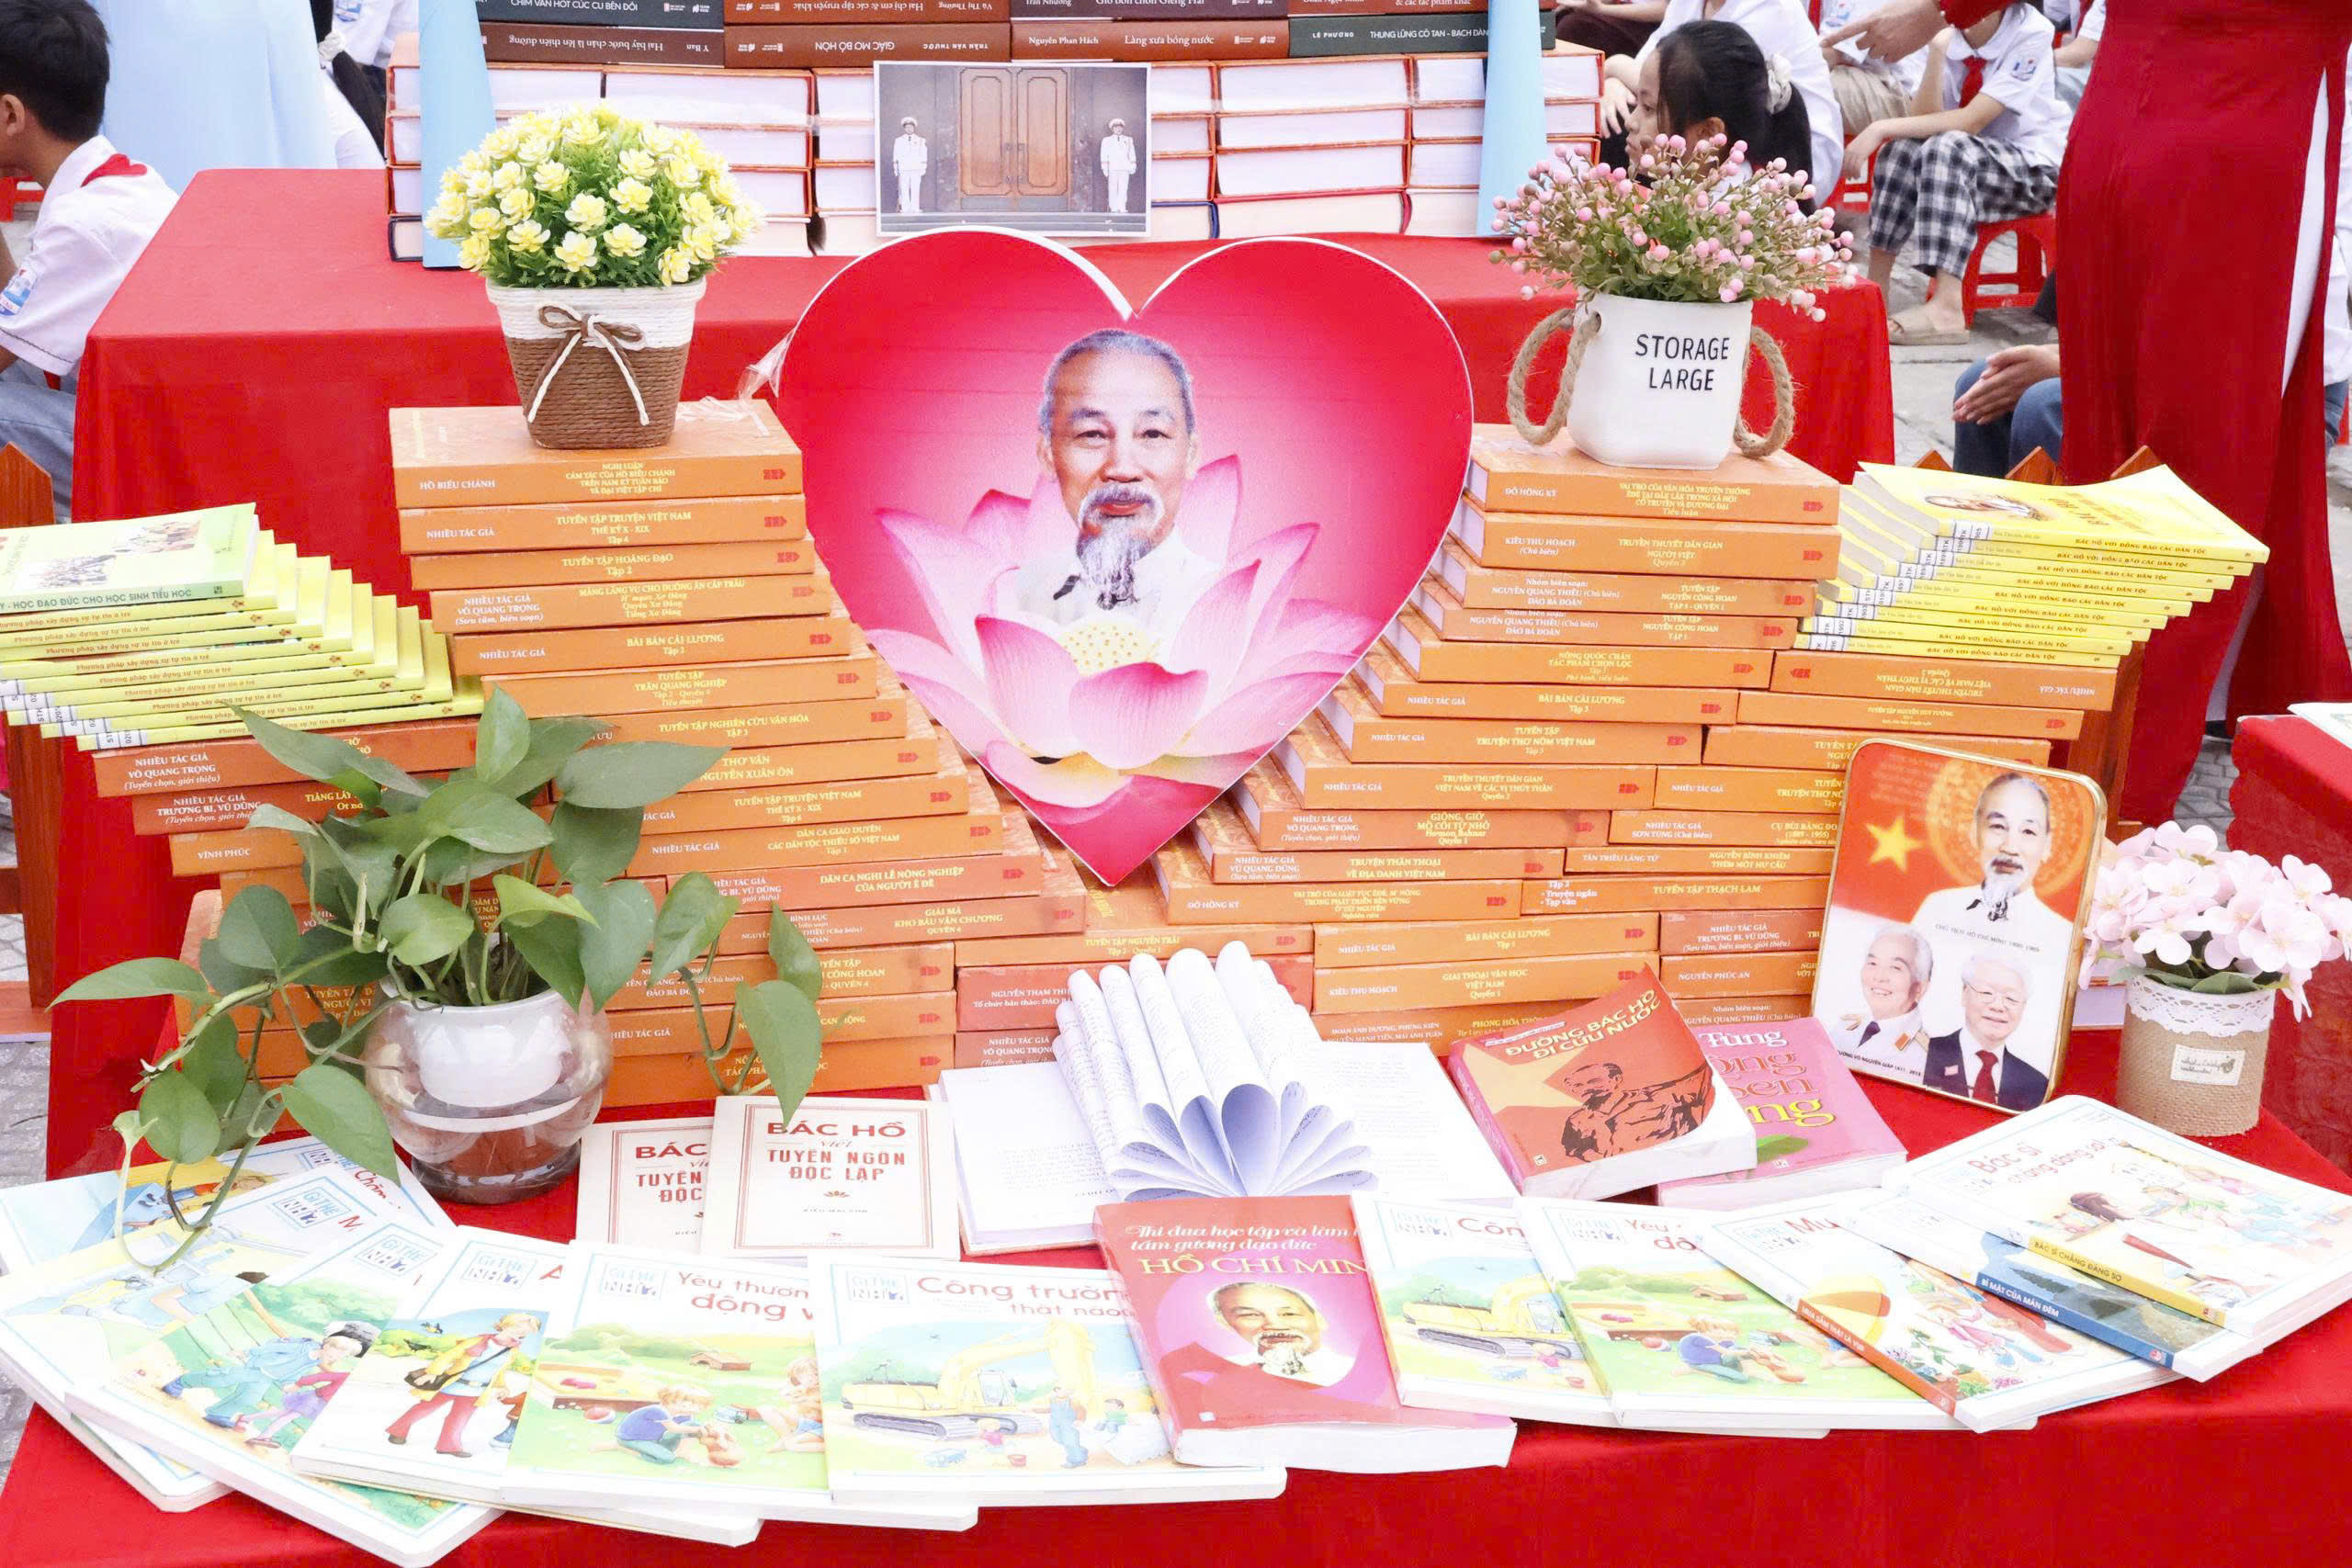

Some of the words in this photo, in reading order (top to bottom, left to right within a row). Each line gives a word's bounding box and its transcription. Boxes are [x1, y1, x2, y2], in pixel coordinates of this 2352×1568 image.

[909, 2, 923, 11] Hai
[648, 42, 663, 51] Hai
[686, 44, 701, 52] Ban
[1125, 35, 1148, 47] Làng
[1148, 36, 1165, 44] xưa
[1167, 34, 1190, 47] bóng
[1635, 333, 1730, 360] STORAGE
[1649, 367, 1714, 390] LARGE
[82, 595, 103, 604] CHO
[129, 592, 150, 601] SINH
[170, 755, 189, 763] TÁC
[144, 768, 180, 778] QUANG
[842, 873, 856, 882] CA
[1588, 1009, 1627, 1032] BÁC
[1698, 1030, 1789, 1048] Tùng
[1533, 1046, 1557, 1059] ĐI
[767, 1121, 838, 1136] BÁC
[852, 1121, 906, 1137] HỒ
[635, 1142, 707, 1159] BÁC
[767, 1147, 831, 1164] TUYÊN
[848, 1151, 906, 1166] NGÔN
[636, 1170, 702, 1188] TUYÊN
[788, 1166, 832, 1180] ĐỘC
[845, 1167, 885, 1183] LẬP
[659, 1187, 703, 1203] ĐỘC
[1457, 1217, 1525, 1237] Côn
[2034, 1241, 2050, 1253] BÁC
[1139, 1252, 1205, 1275] HỒ
[1211, 1256, 1282, 1274] CHÍ
[1294, 1258, 1367, 1274] MIN
[679, 1271, 721, 1288] Yêu
[734, 1280, 808, 1299] thươn
[917, 1275, 1015, 1303] Công
[691, 1293, 786, 1321] động
